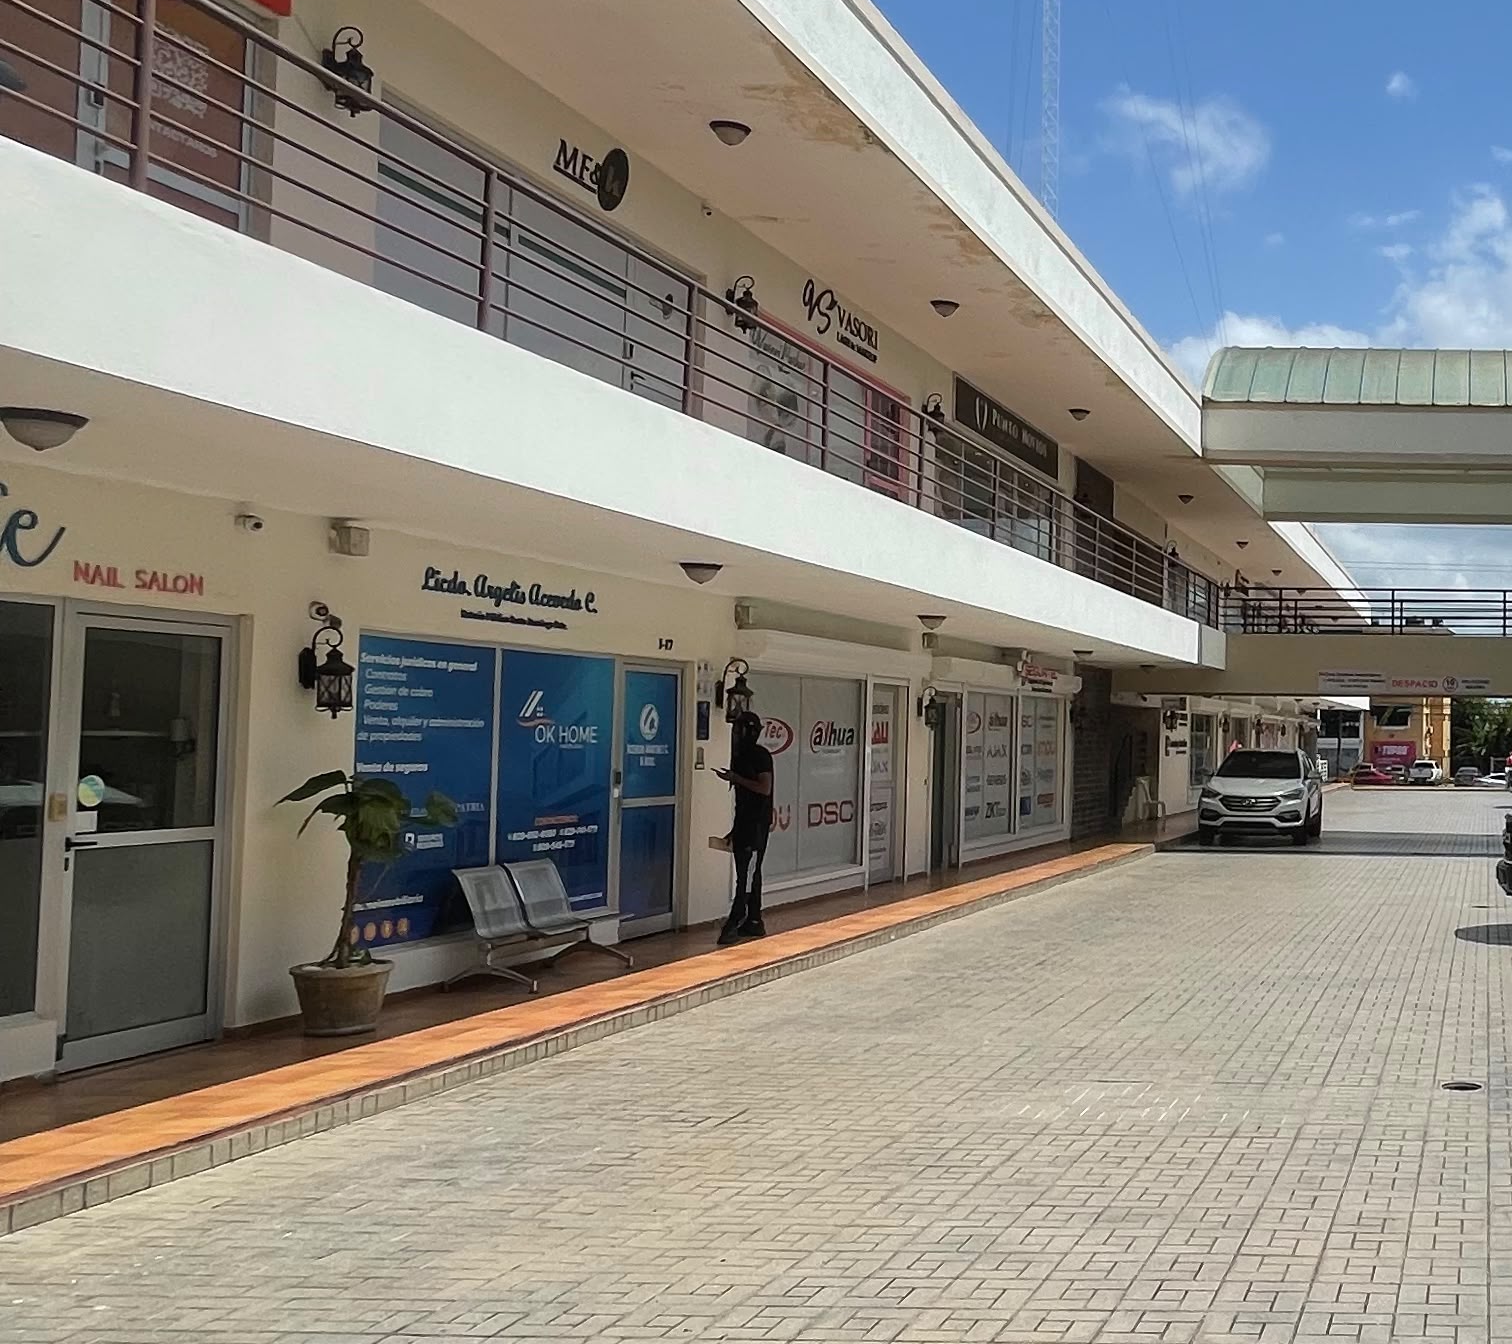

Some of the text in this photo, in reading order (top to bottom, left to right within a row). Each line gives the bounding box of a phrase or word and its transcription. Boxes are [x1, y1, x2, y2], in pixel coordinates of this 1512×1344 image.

[837, 304, 878, 351] VASORI
[73, 560, 204, 596] NAIL SALON
[1392, 679, 1438, 689] DESPACIO
[534, 725, 598, 744] OK HOME
[807, 800, 855, 828] DSC
